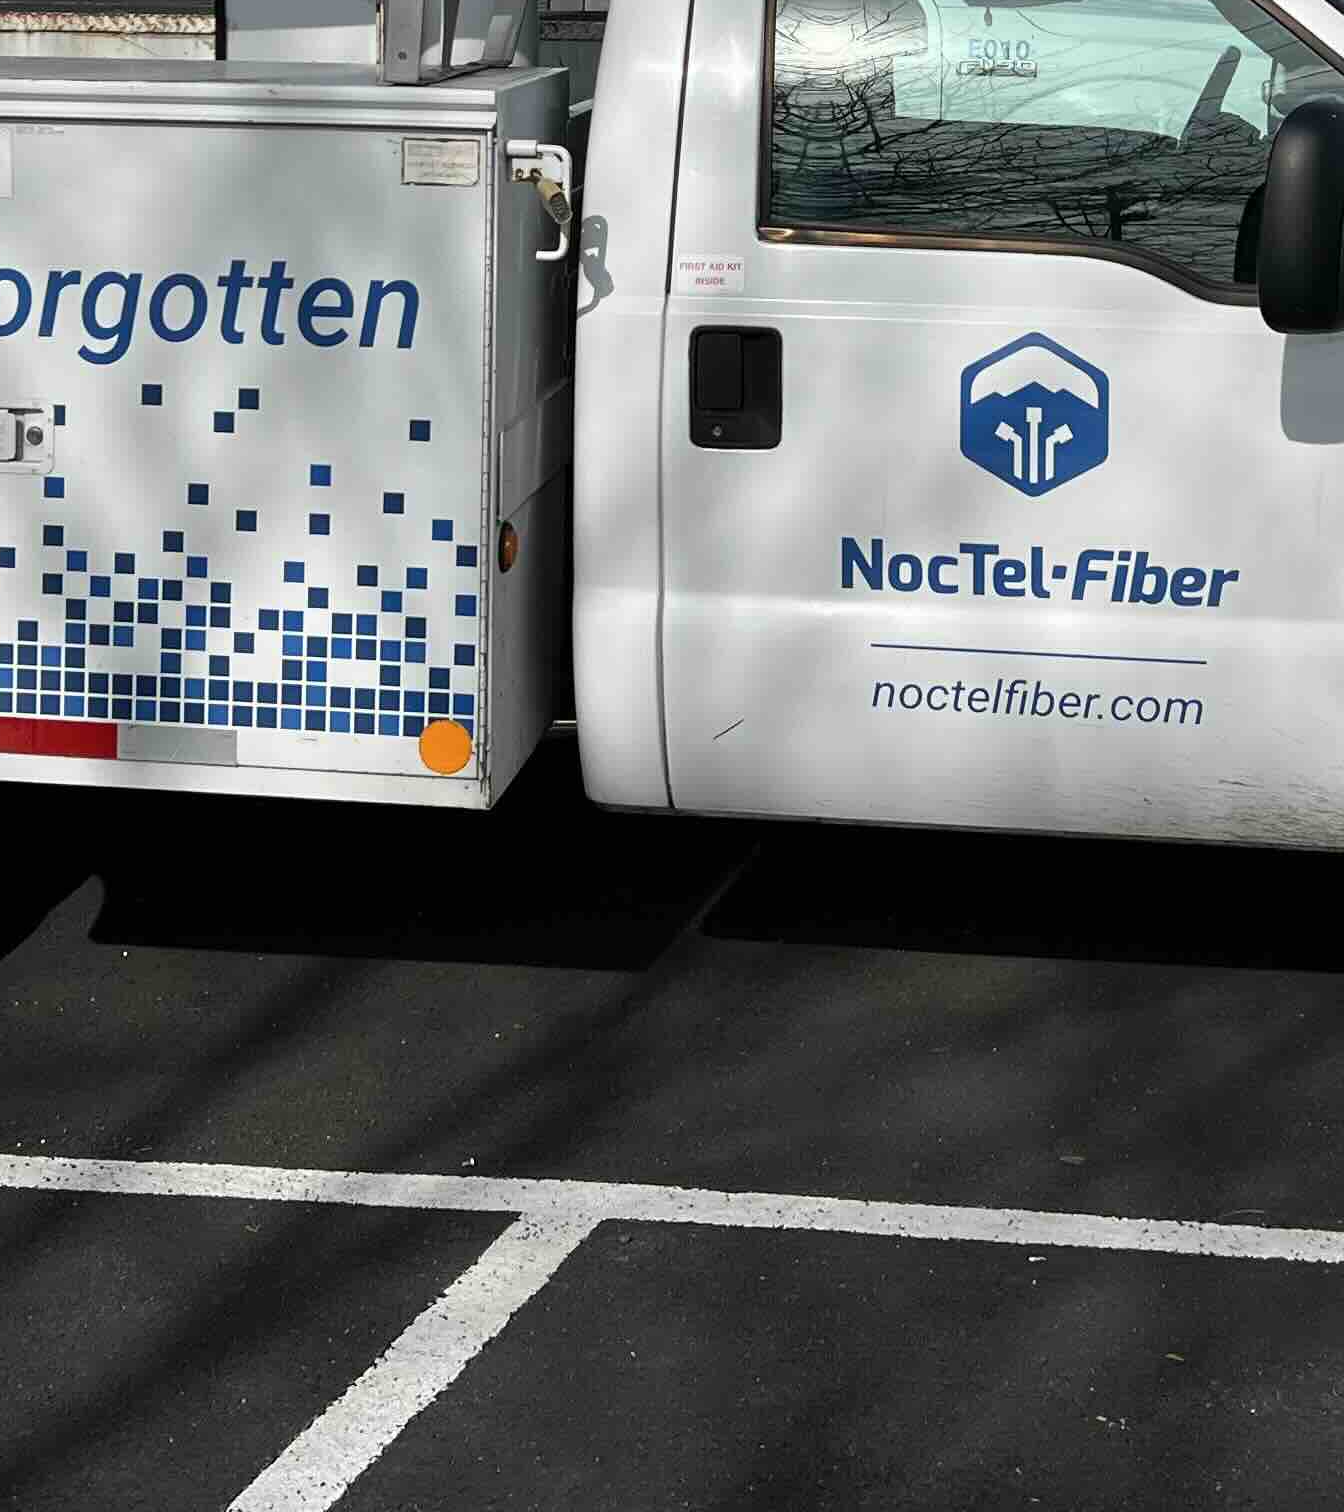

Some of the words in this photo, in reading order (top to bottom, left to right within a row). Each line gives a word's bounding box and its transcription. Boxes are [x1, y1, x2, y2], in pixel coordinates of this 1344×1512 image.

[968, 39, 1031, 59] E010
[710, 263, 725, 271] AID
[871, 678, 1204, 726] noctelfiber.com
